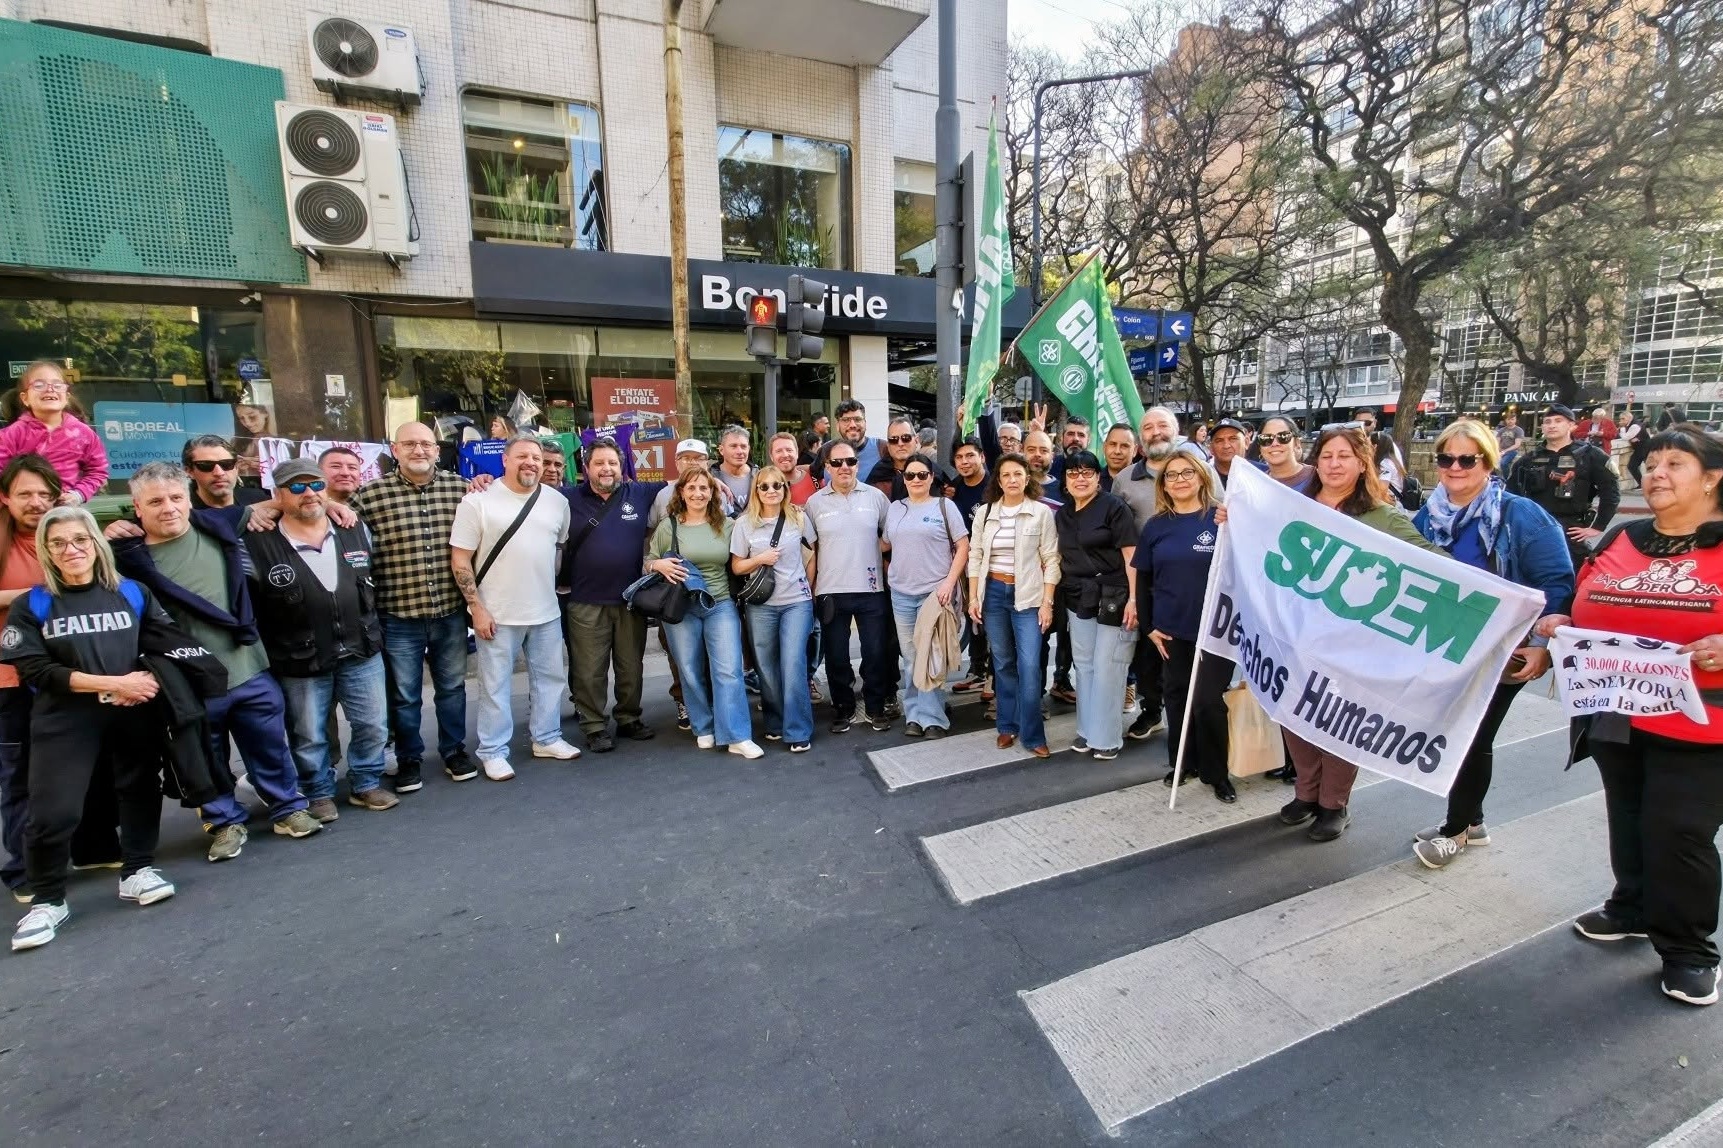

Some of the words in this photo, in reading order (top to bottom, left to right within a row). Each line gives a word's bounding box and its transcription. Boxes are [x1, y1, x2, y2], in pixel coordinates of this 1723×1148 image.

[701, 274, 889, 320] Bonfide
[609, 395, 624, 405] EL
[625, 396, 660, 405] DOBLE
[124, 421, 184, 432] BOREAL
[596, 429, 617, 438] MENOS
[109, 449, 167, 459] Cuidamos
[632, 445, 665, 469] x1
[1593, 573, 1611, 585] LA
[1589, 594, 1632, 604] RESISTENCIA
[1634, 598, 1711, 608] LATINOAMERICANA
[42, 610, 132, 640] LEALTAD
[1584, 656, 1619, 671] 30.000
[1621, 658, 1690, 682] RAZONES
[1567, 677, 1584, 691] La
[1588, 675, 1688, 702] MEMORIA
[1572, 694, 1596, 709] está
[1597, 696, 1611, 707] en
[1617, 695, 1634, 712] la
[1293, 670, 1448, 774] Humanos
